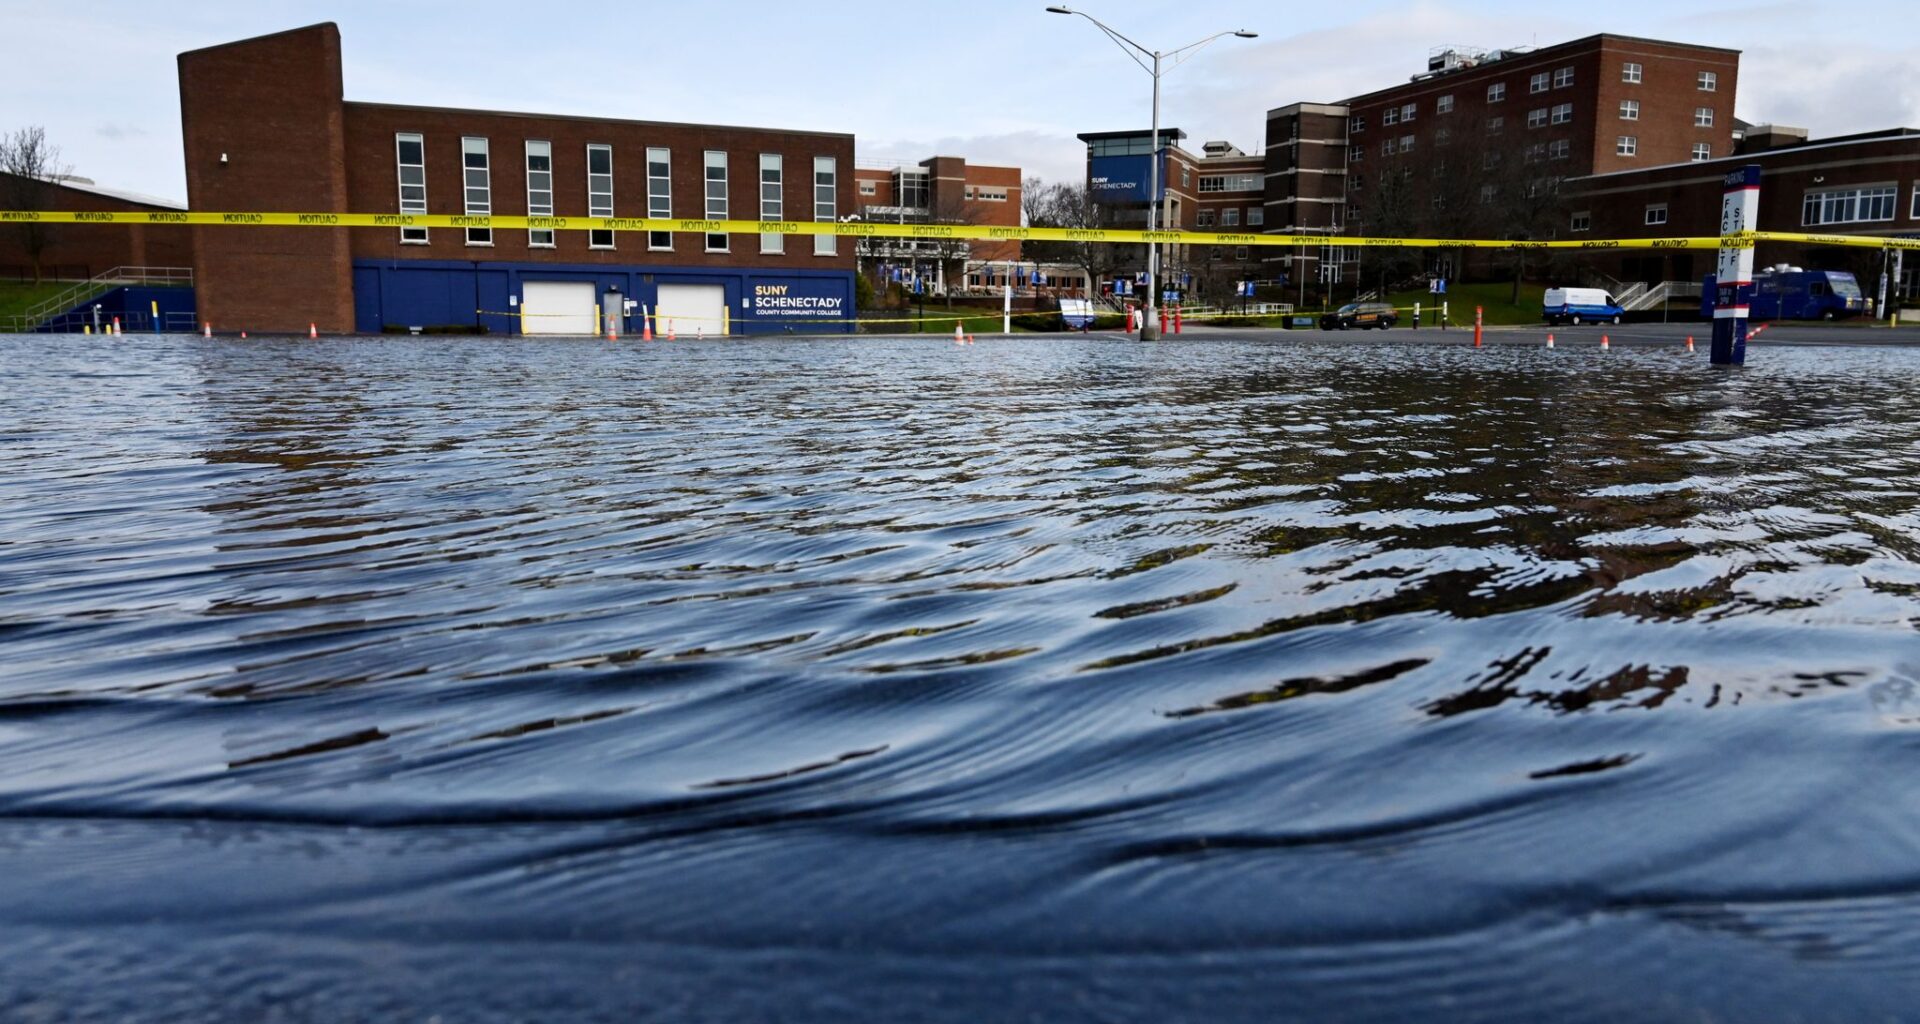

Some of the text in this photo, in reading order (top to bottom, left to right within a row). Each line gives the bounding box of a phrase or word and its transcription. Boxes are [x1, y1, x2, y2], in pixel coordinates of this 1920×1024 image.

[1731, 207, 1740, 266] STFF
[755, 285, 788, 295] SUNY
[755, 297, 842, 308] SCHENECTADY
